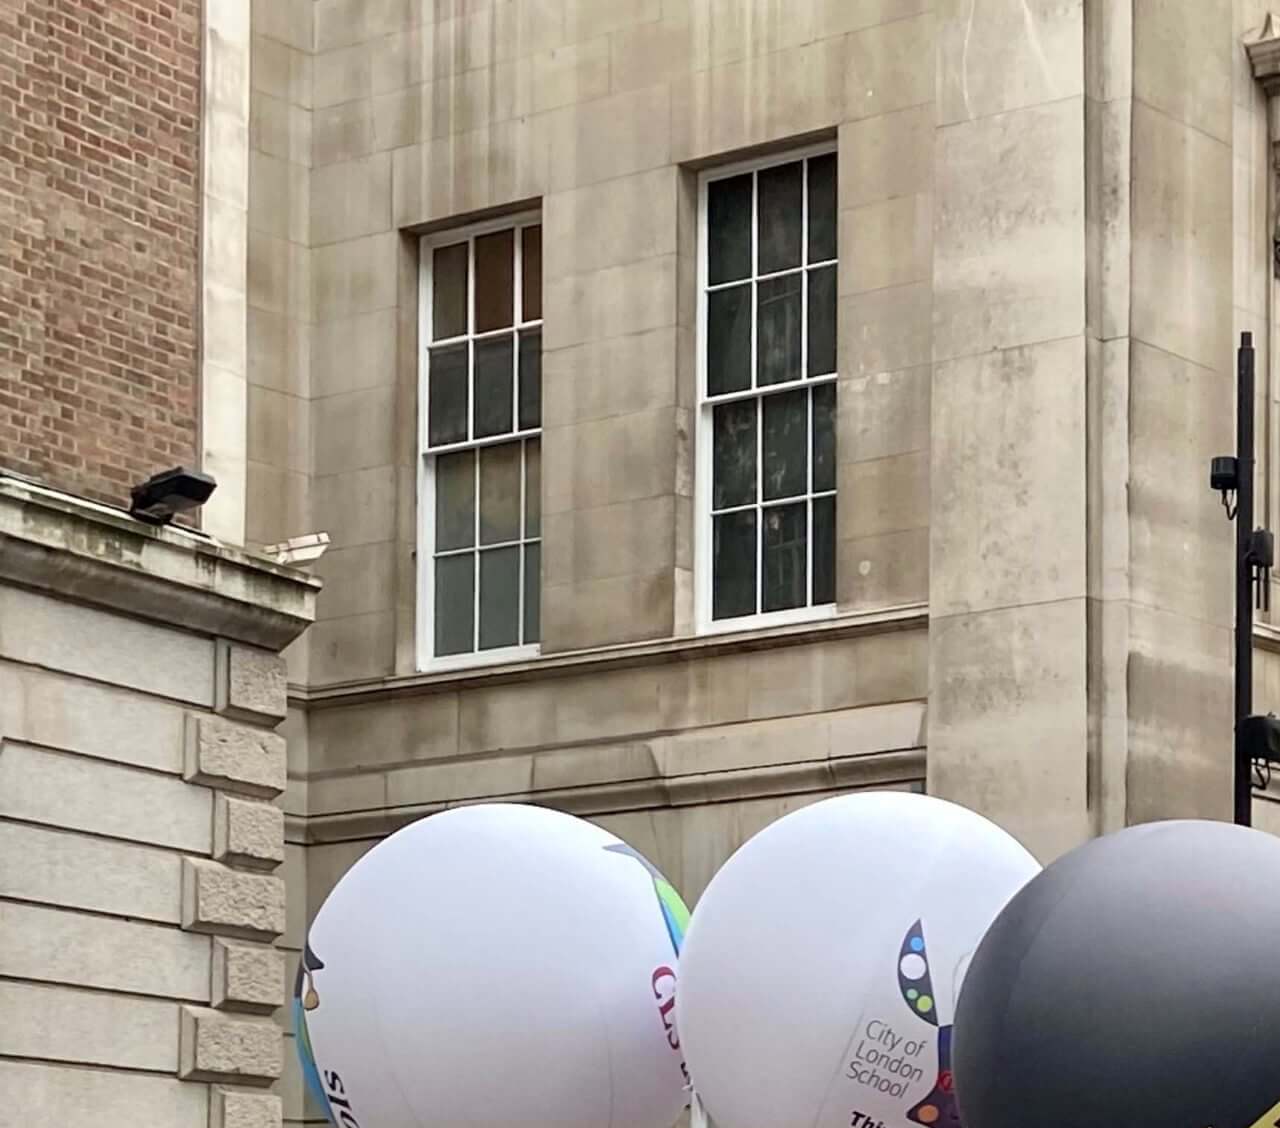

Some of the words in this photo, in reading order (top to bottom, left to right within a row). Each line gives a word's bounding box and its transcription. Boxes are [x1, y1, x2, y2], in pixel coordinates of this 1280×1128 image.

[866, 1019, 902, 1052] City
[904, 1039, 927, 1058] of
[847, 1061, 911, 1100] School
[856, 1040, 924, 1083] London
